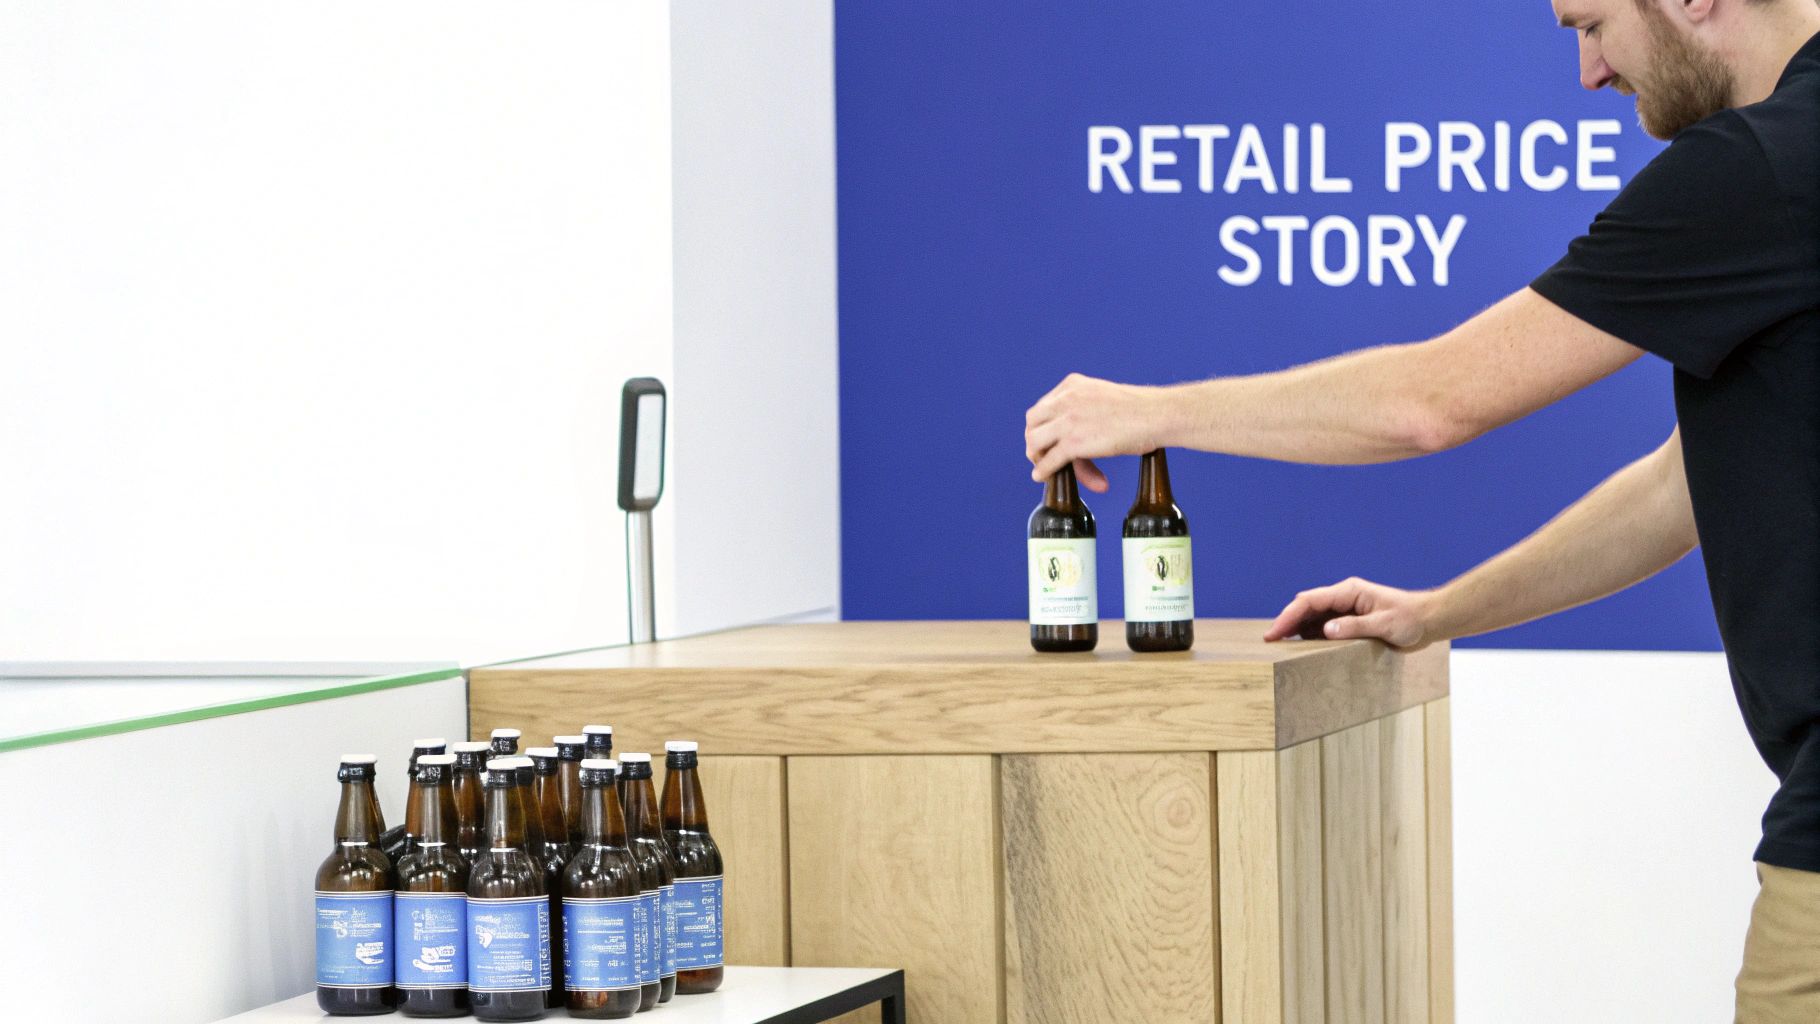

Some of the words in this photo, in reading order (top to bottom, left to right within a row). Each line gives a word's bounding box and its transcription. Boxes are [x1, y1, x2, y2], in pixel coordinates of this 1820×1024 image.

[1087, 123, 1353, 194] RETAIL
[1384, 119, 1622, 193] PRICE
[1217, 214, 1467, 287] STORY
